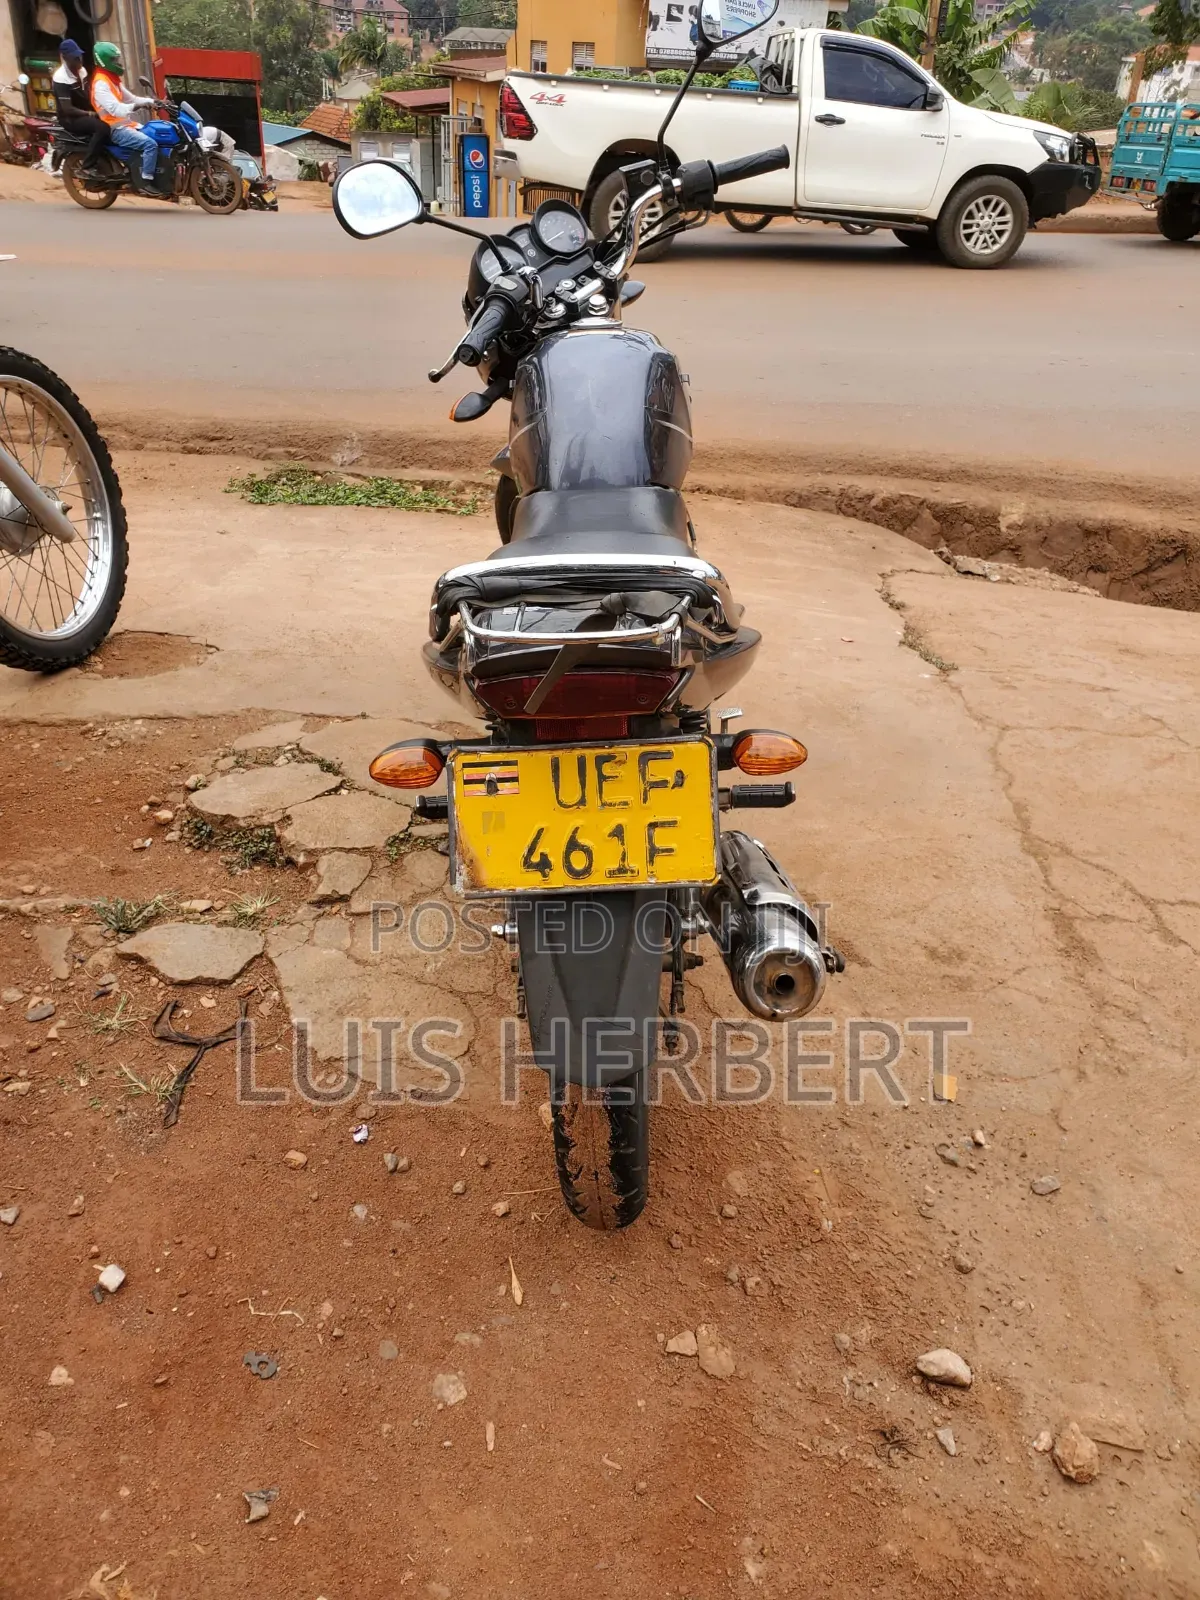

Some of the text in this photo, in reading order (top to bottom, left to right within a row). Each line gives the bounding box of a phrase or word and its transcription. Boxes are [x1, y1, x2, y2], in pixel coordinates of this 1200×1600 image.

[471, 174, 483, 208] pepsi
[550, 749, 675, 809] UEF
[520, 818, 680, 881] 461F
